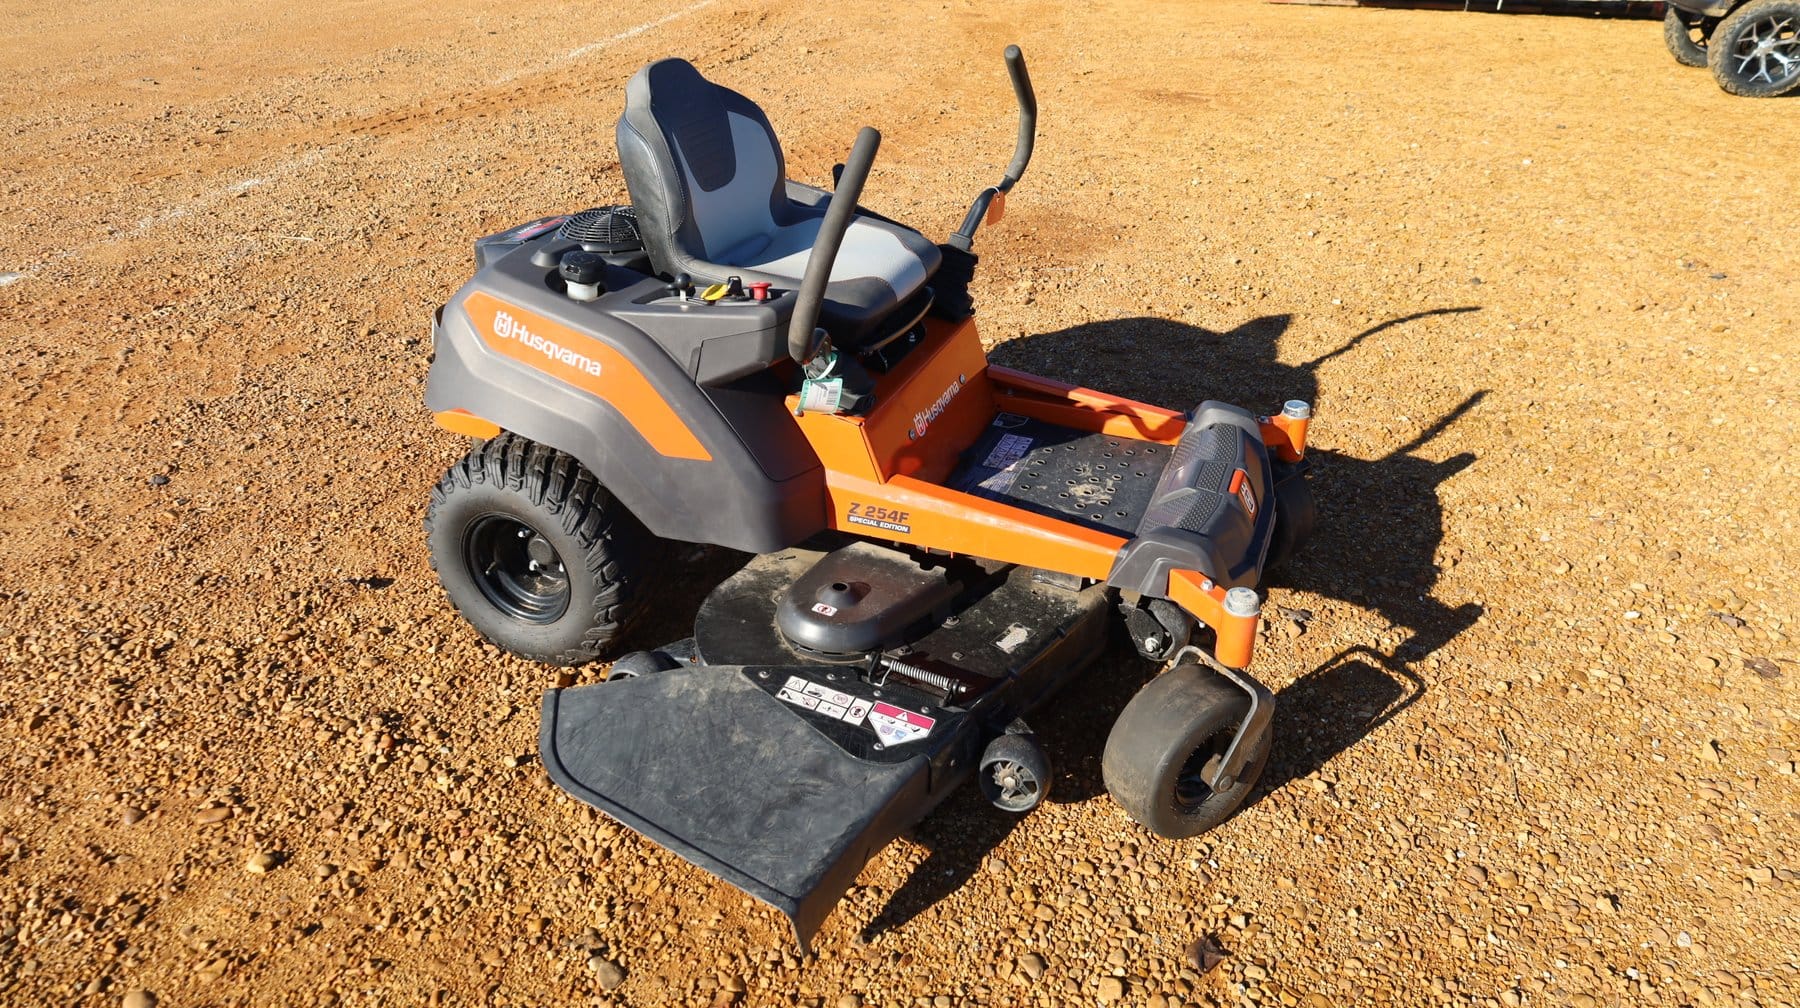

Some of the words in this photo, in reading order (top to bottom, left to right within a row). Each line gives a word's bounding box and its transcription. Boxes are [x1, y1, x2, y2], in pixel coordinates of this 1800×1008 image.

[511, 321, 602, 377] Husqvarna
[921, 380, 960, 427] Husqvarna
[848, 502, 861, 514] Z
[865, 505, 910, 524] 254F
[848, 515, 879, 527] SPECIAL
[879, 521, 909, 533] EDITION
